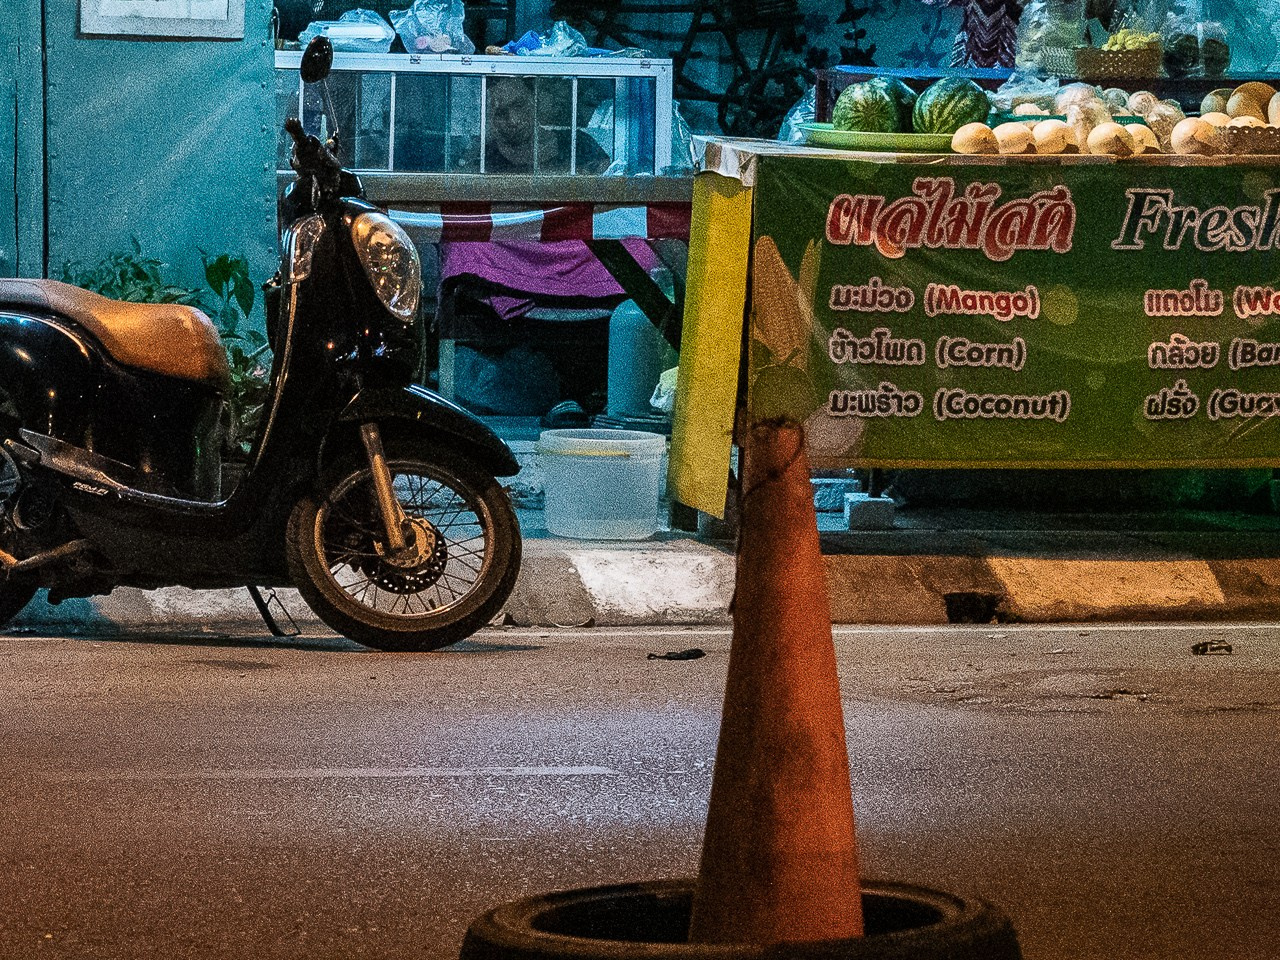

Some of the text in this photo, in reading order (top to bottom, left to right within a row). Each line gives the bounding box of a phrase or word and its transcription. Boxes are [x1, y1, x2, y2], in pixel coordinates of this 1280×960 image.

[826, 177, 1076, 261] ผลไม้สด
[830, 278, 1039, 321] มะม่วง (Mango)
[1144, 279, 1223, 316] แตงโม
[829, 328, 1026, 370] ข้าวโพด (Corn)
[1148, 333, 1220, 368] กล้วย
[829, 382, 1071, 422] มะพร้าว (Coconut)
[1144, 380, 1199, 418] ฝรั่ง
